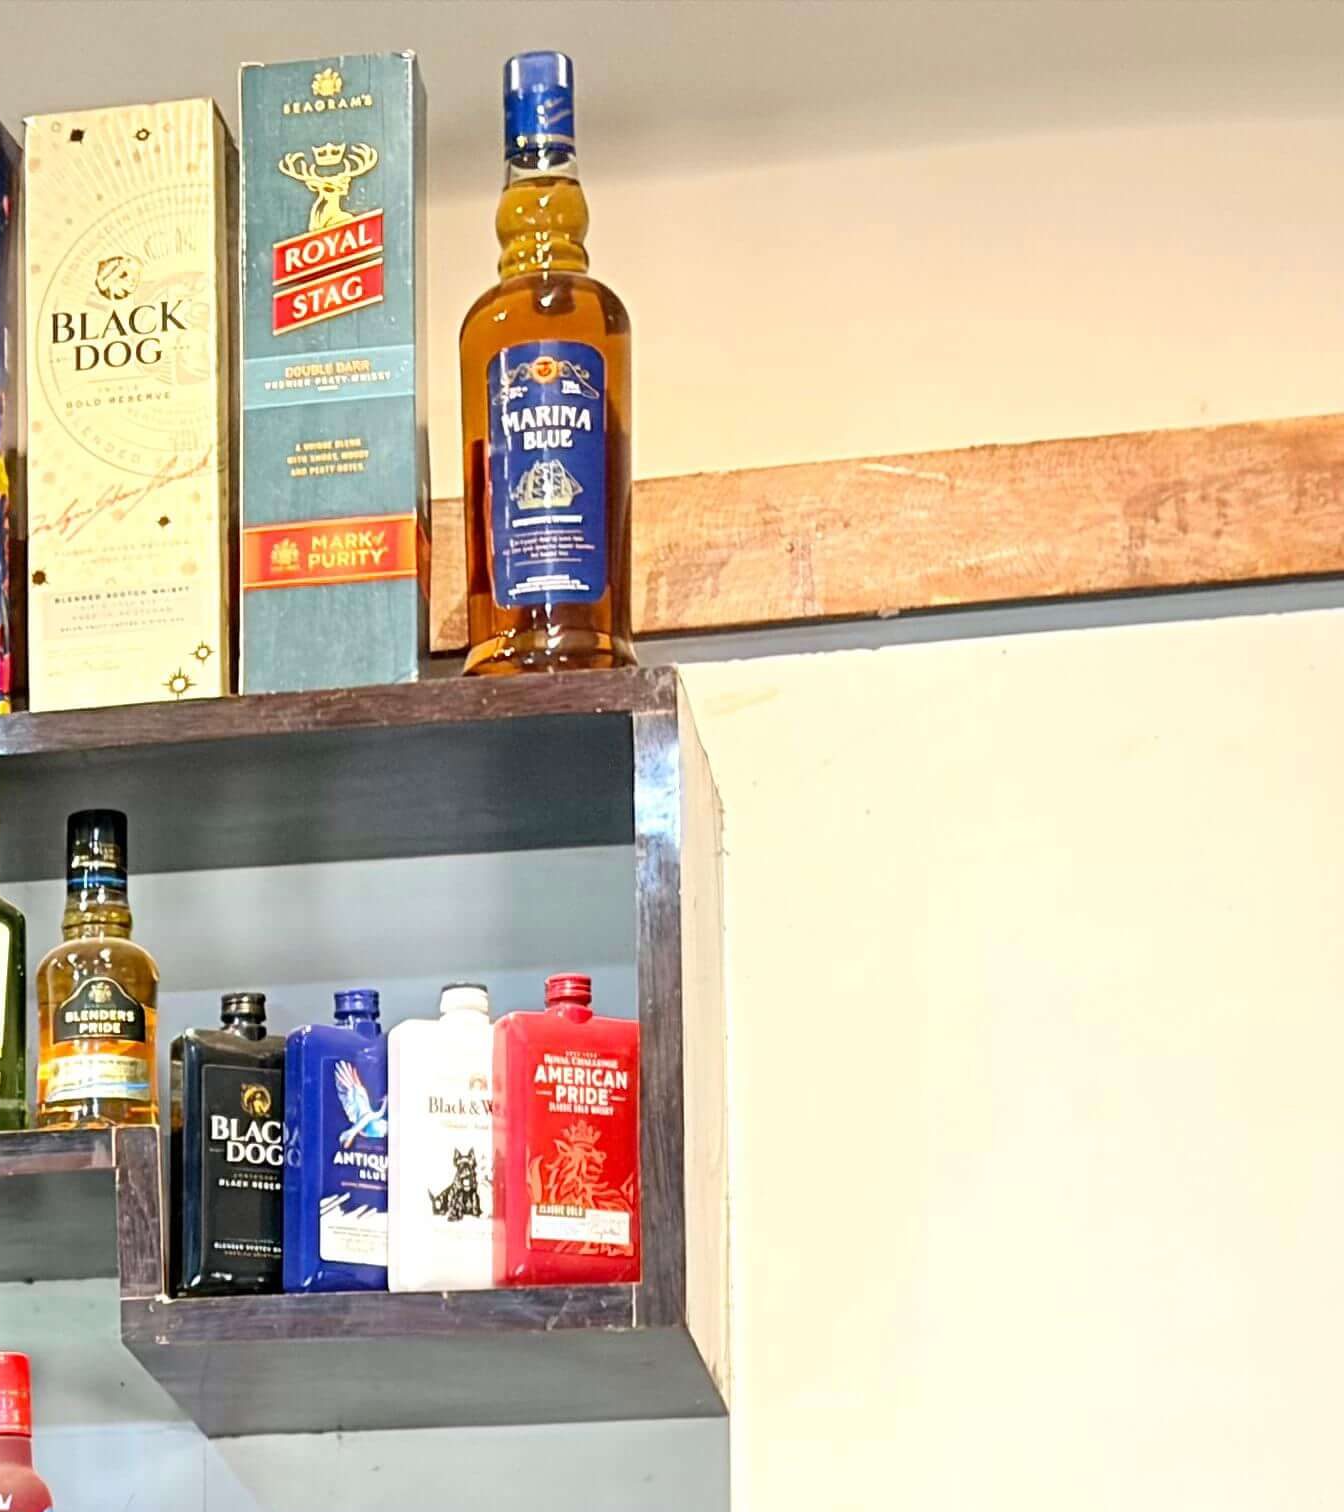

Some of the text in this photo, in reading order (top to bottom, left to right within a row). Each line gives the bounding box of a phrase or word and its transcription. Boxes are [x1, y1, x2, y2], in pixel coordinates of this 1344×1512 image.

[284, 223, 373, 273] ROYAL
[291, 276, 362, 319] STAG
[51, 300, 187, 344] BLACK
[74, 338, 162, 371] DOG
[501, 405, 591, 433] MARINA
[523, 429, 573, 450] BLUE
[311, 531, 372, 551] MARK
[308, 547, 386, 570] PURITY
[65, 1009, 135, 1023] BLENDERS
[78, 1021, 121, 1035] PRIDE
[534, 1064, 628, 1089] AMERICAN
[428, 1096, 466, 1115] Black
[555, 1085, 609, 1105] PRIDE
[211, 1115, 283, 1144] BLAC
[226, 1141, 284, 1166] DOG
[333, 1151, 388, 1172] ANTIQU
